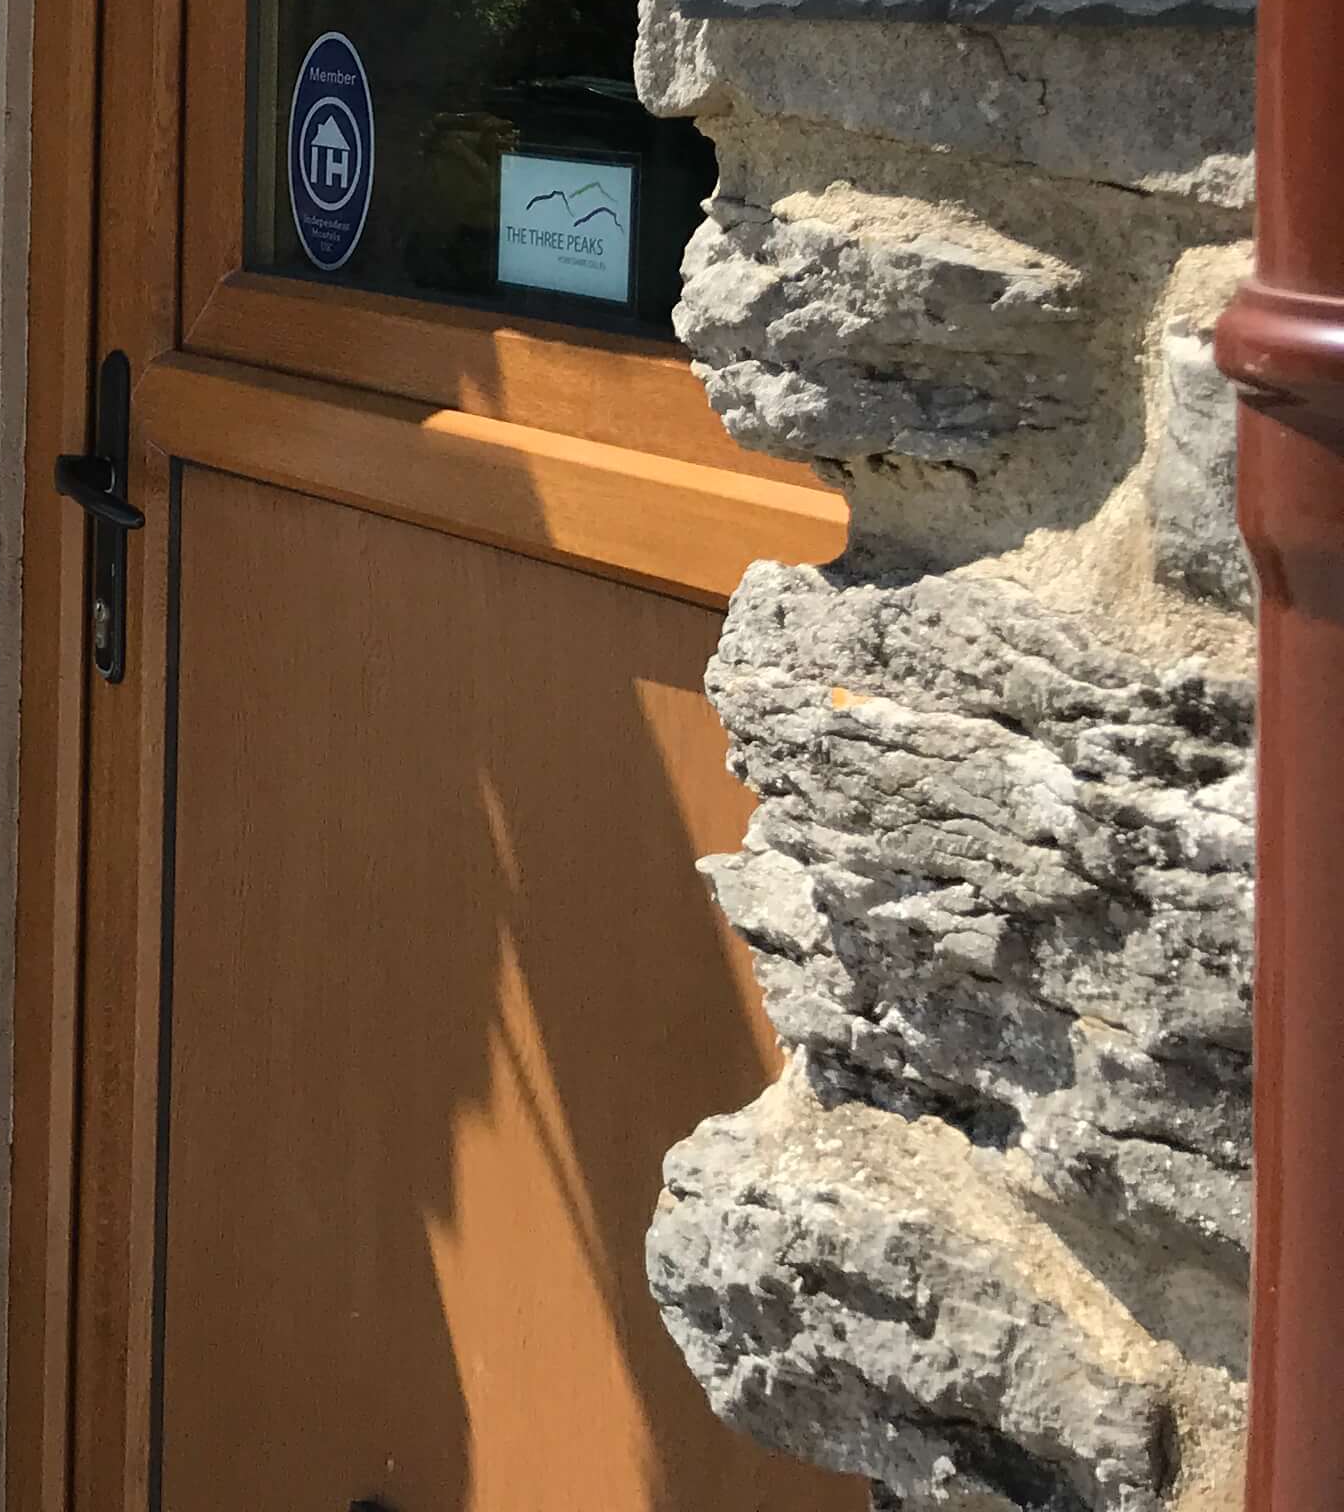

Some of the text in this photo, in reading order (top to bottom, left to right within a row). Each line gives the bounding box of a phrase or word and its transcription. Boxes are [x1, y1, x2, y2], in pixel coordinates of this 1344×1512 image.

[309, 67, 357, 86] Member
[506, 226, 604, 256] THE THREE PEAKS
